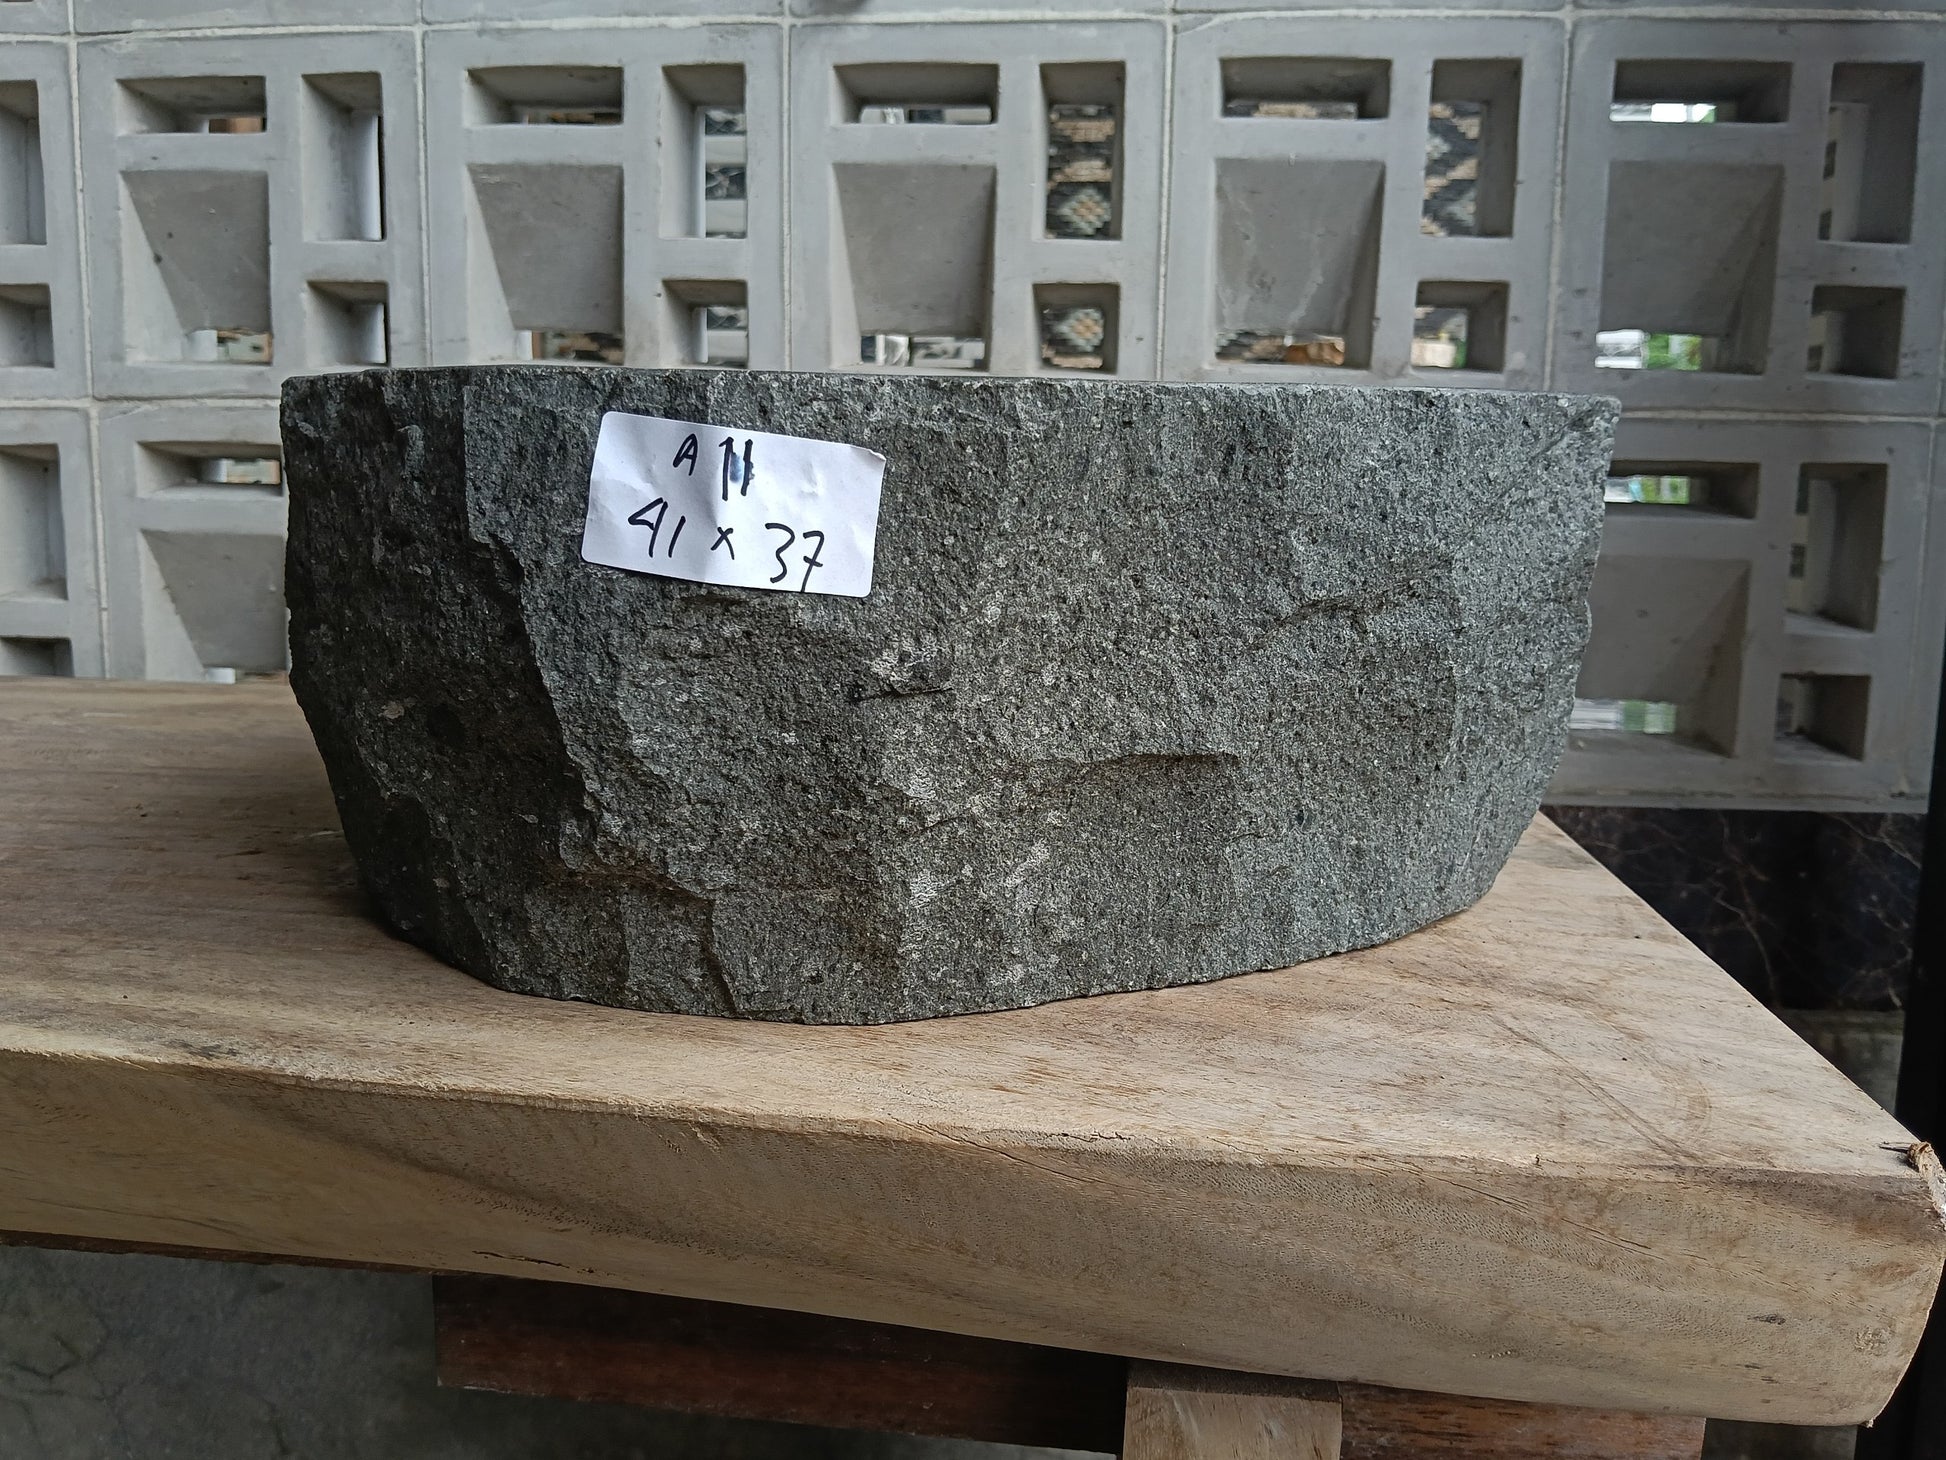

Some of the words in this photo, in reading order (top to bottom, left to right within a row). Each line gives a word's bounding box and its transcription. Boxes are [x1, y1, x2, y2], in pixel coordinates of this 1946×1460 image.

[672, 433, 698, 476] A
[627, 497, 686, 558] 41
[765, 522, 825, 592] 37
